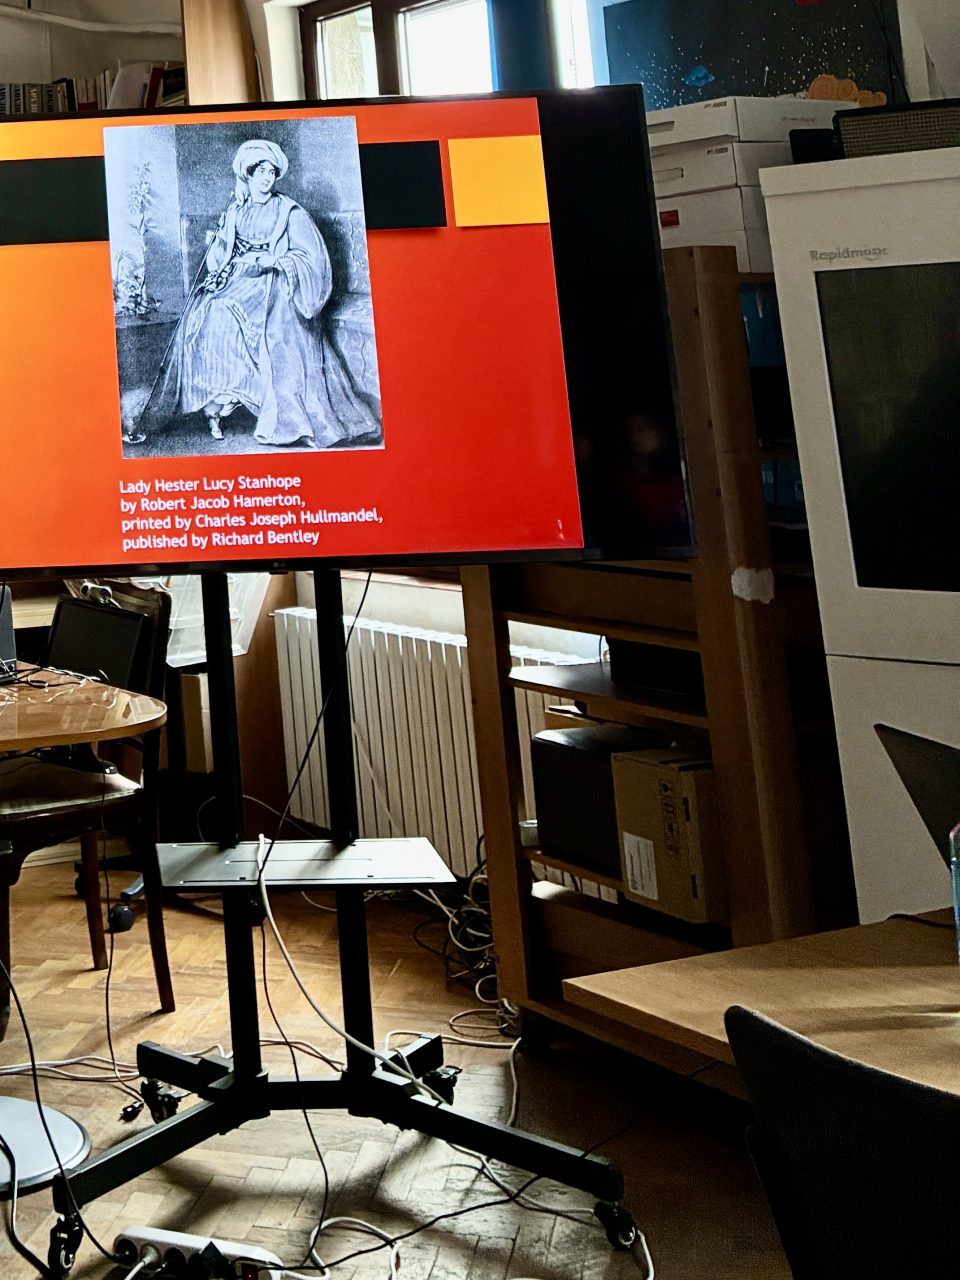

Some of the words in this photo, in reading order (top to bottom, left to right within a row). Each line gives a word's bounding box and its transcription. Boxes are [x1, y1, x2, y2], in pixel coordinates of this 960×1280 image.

[119, 480, 151, 496] Lady
[155, 478, 199, 492] Hester
[203, 477, 235, 492] Lucy
[238, 475, 301, 490] Stanhope
[120, 499, 137, 514] by
[140, 497, 187, 512] Robert
[190, 495, 230, 510] Jacob
[233, 493, 305, 508] Hamerton,
[121, 516, 171, 533] printed
[174, 515, 192, 531] by
[195, 513, 246, 528] Charles
[250, 510, 296, 528] Joseph
[300, 507, 383, 524] Hullmandel,
[122, 534, 188, 552] published
[191, 533, 208, 549] by
[212, 531, 264, 546] Richard
[267, 529, 320, 546] Bentley
